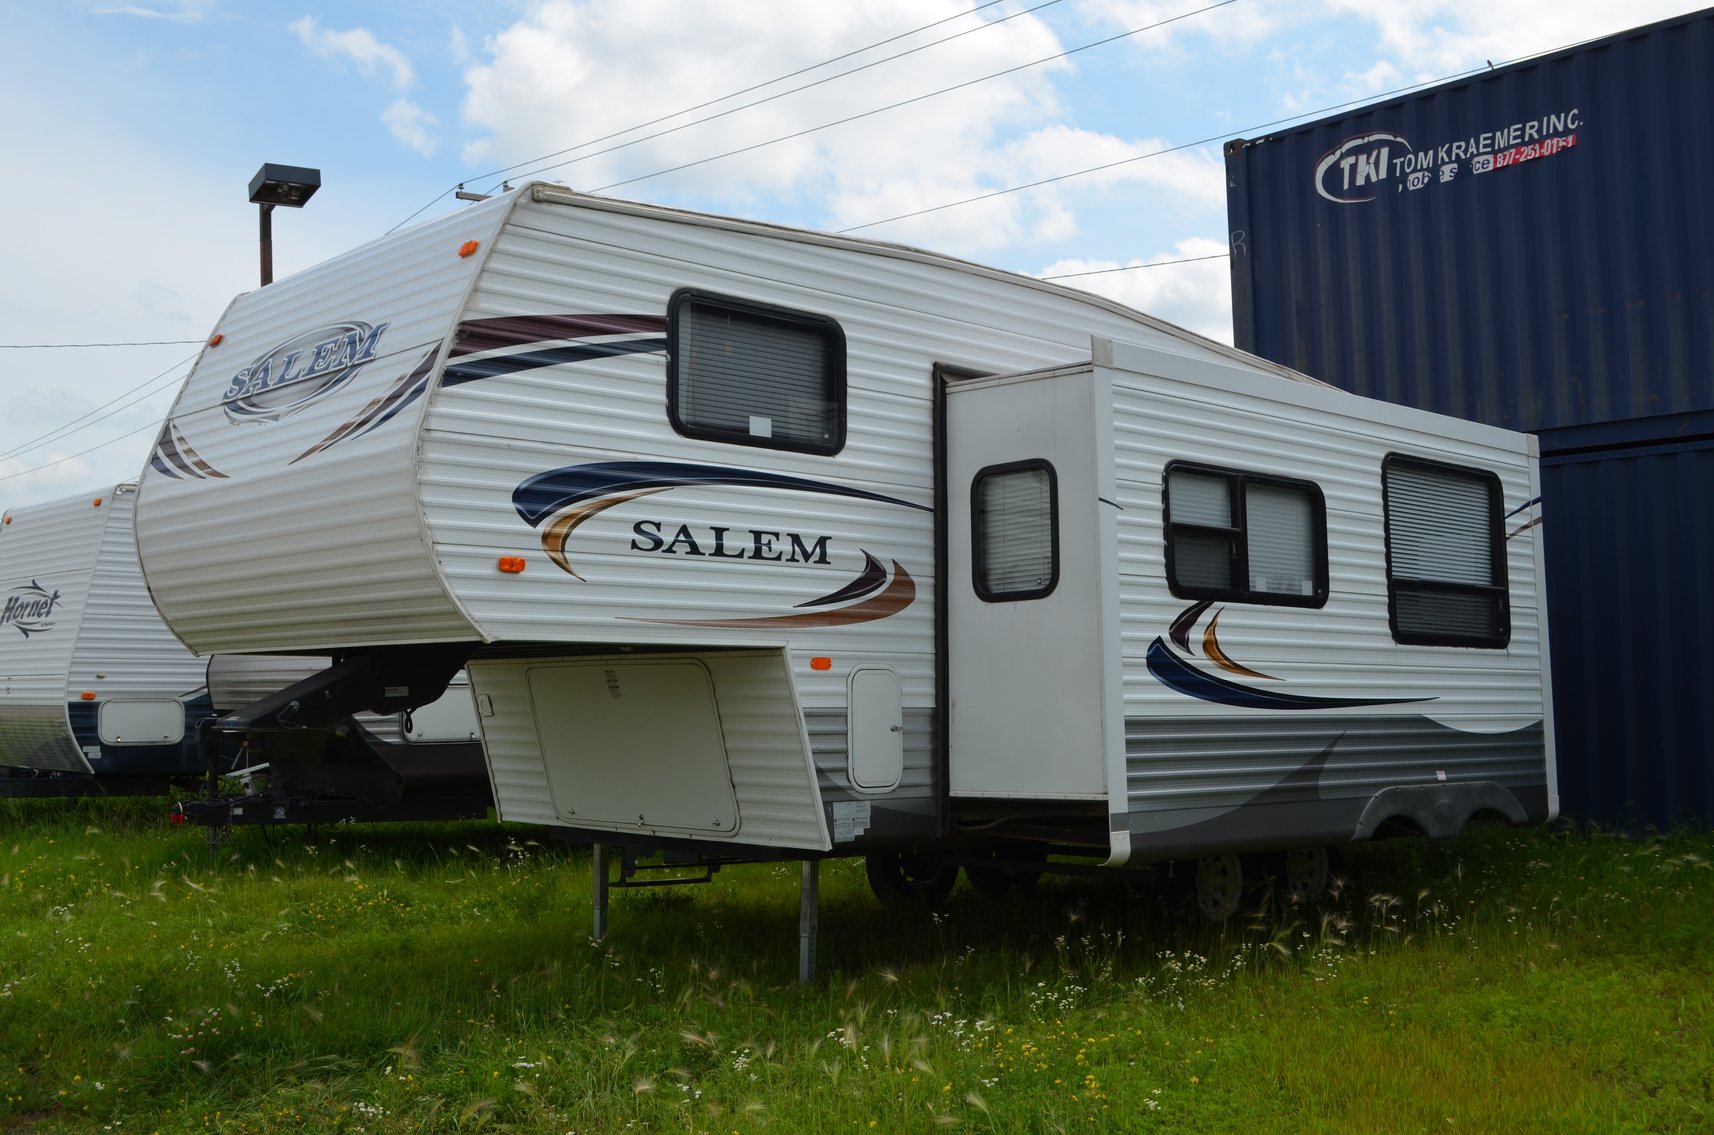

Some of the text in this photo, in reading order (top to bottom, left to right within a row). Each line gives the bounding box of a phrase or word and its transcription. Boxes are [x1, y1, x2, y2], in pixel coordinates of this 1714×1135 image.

[1393, 149, 1434, 177] TOM
[1438, 121, 1539, 164] KRAEMER
[1542, 108, 1584, 136] INC.
[1340, 147, 1390, 190] TKI
[222, 321, 391, 403] SALEM
[630, 520, 832, 565] SALEM
[0, 589, 61, 626] Hornet
